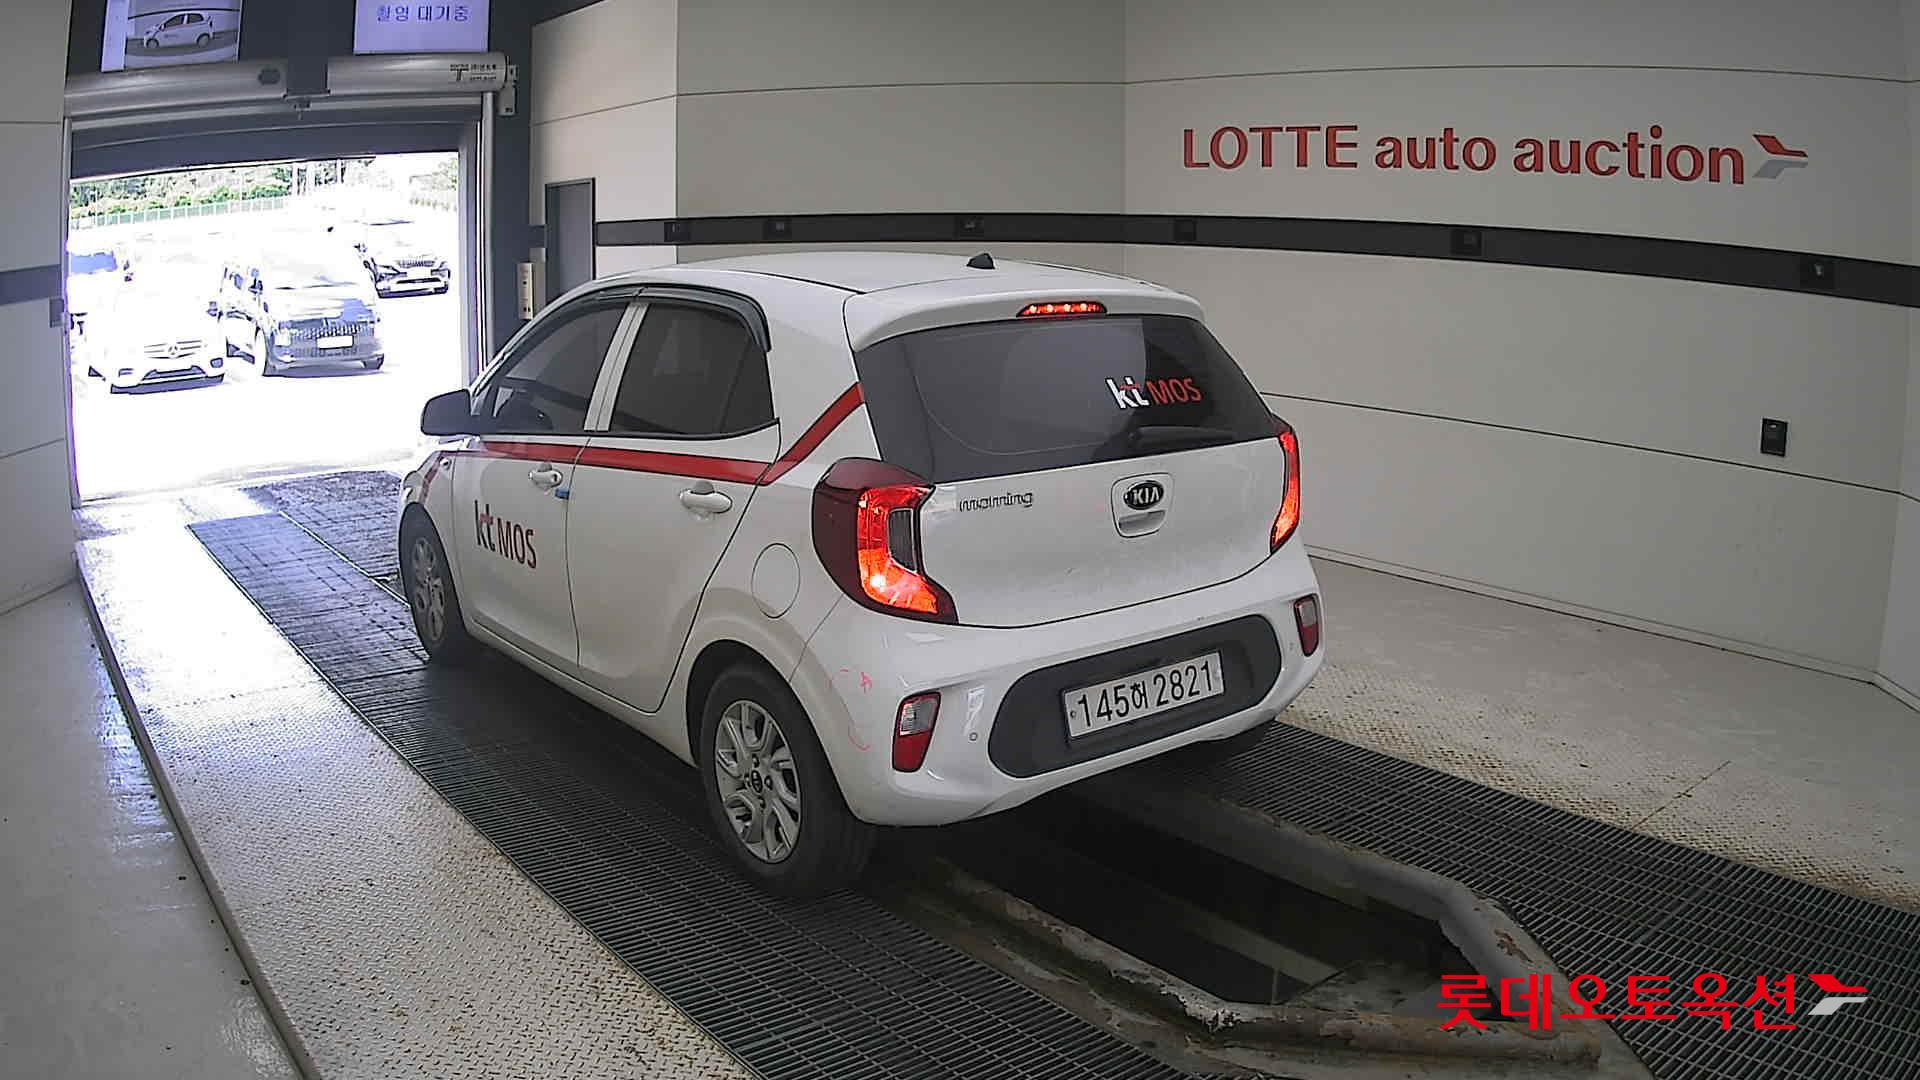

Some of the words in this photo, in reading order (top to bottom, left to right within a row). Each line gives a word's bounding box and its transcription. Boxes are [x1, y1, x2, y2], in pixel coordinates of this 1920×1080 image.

[1183, 125, 1358, 169] LOTTE
[1374, 127, 1497, 171] auto
[1513, 125, 1745, 185] auction
[1106, 377, 1149, 409] kt
[1146, 378, 1203, 405] MOS
[474, 499, 496, 552] kt
[497, 516, 537, 569] MOS
[1077, 680, 1149, 727] 145허
[1153, 660, 1213, 707] 2821
